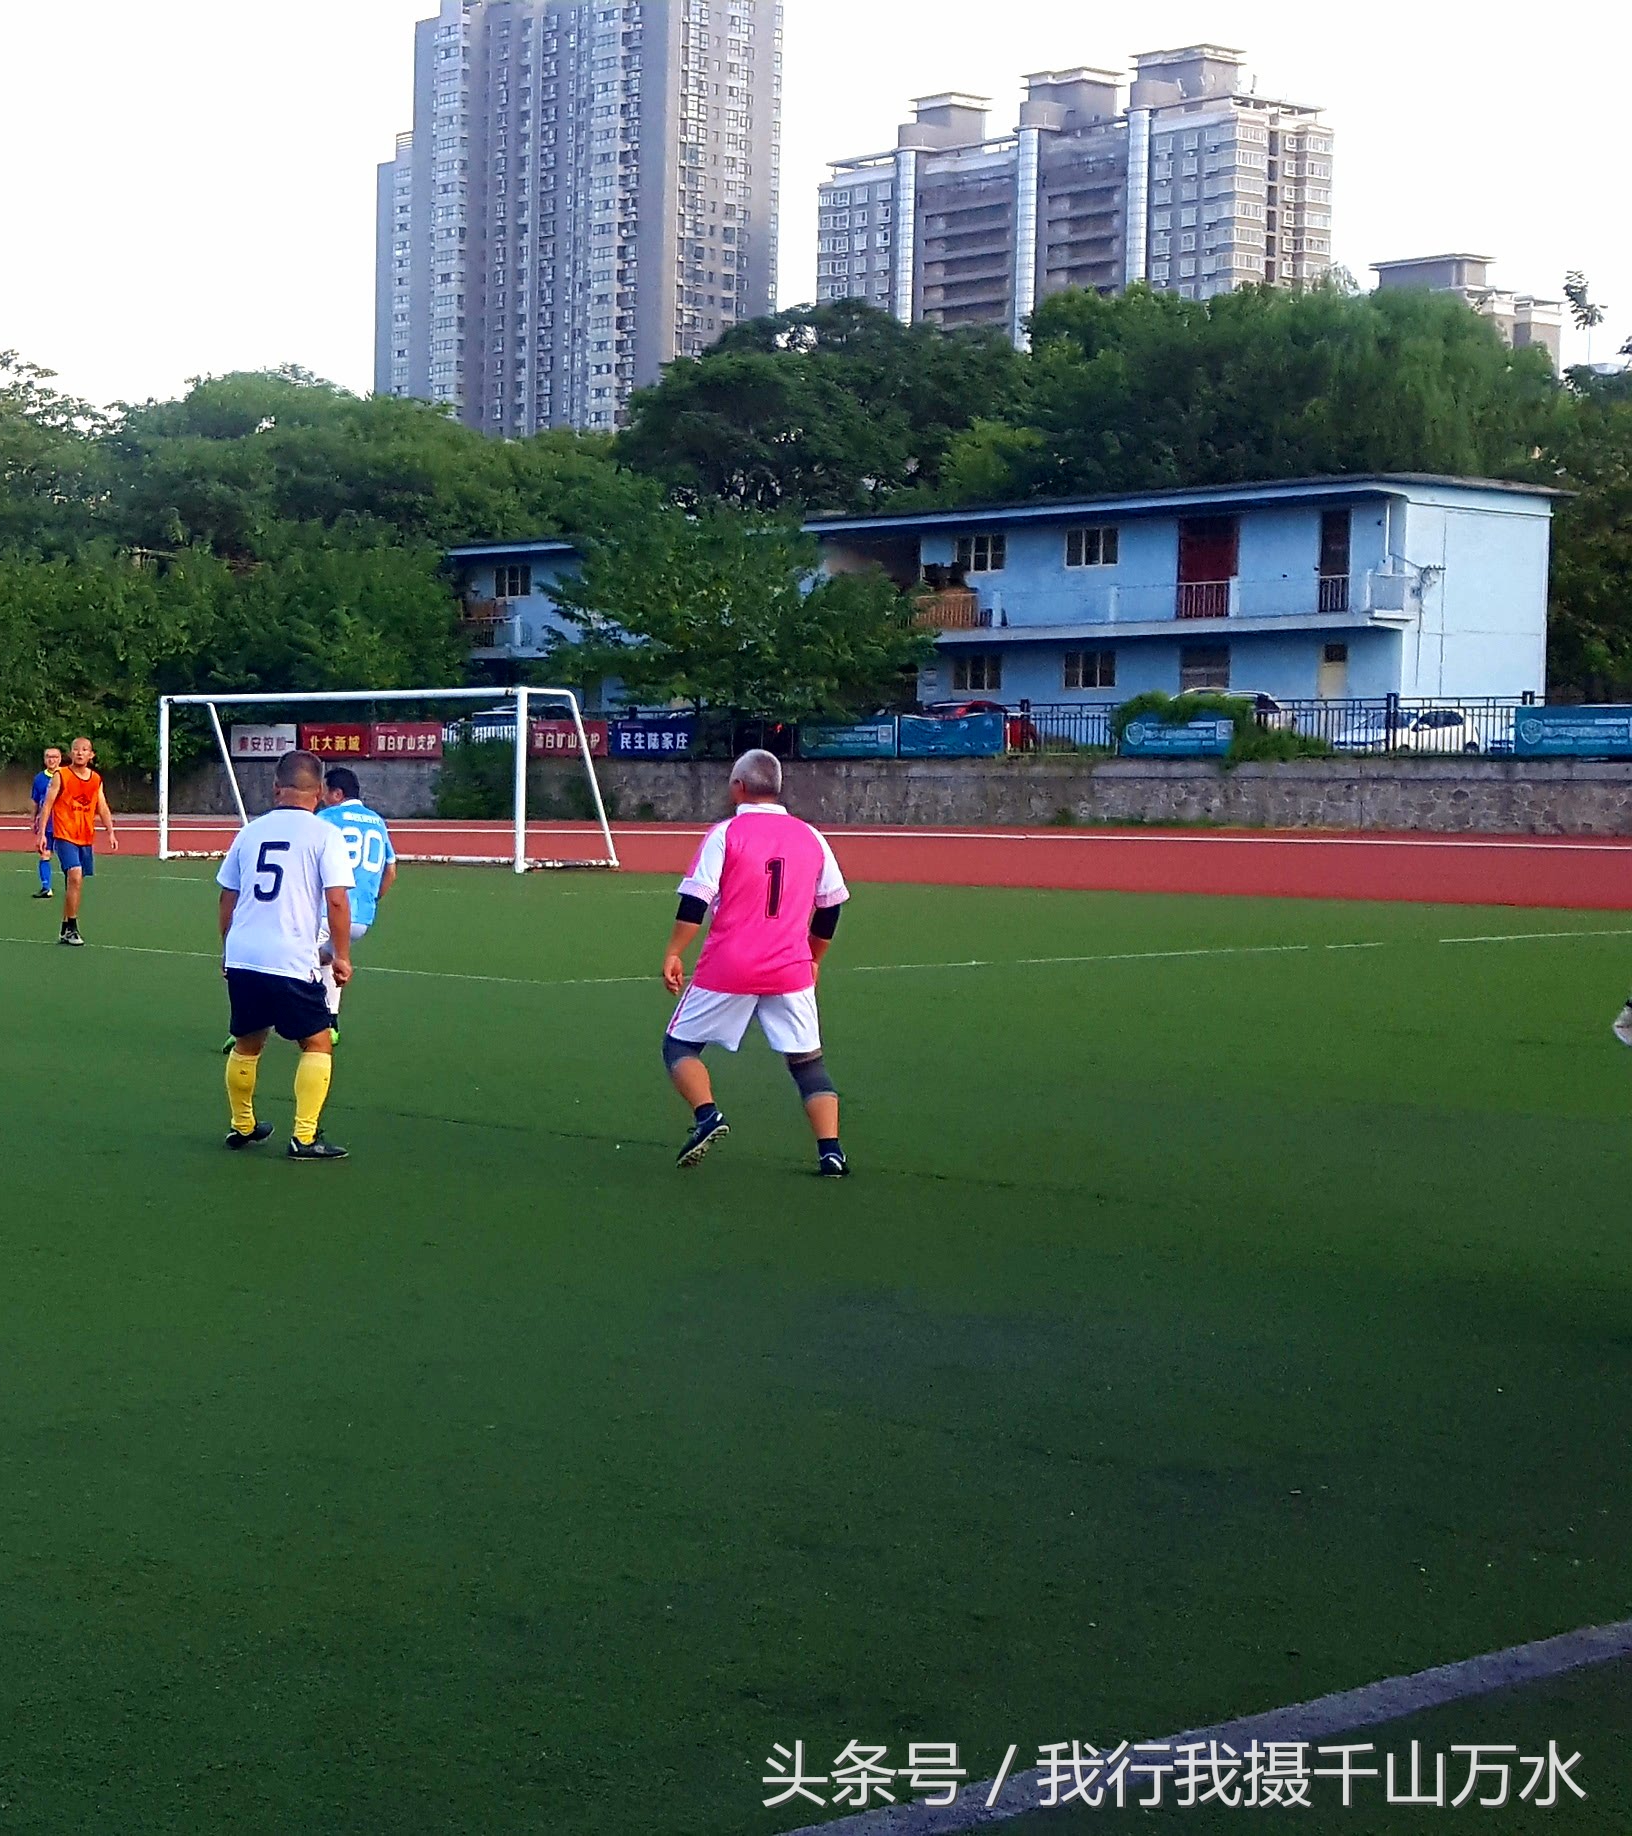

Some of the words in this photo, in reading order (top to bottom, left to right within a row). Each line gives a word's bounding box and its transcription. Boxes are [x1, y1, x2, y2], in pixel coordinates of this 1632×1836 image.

[309, 734, 361, 752] 北大新城
[253, 841, 291, 903] 5
[764, 856, 786, 920] 1
